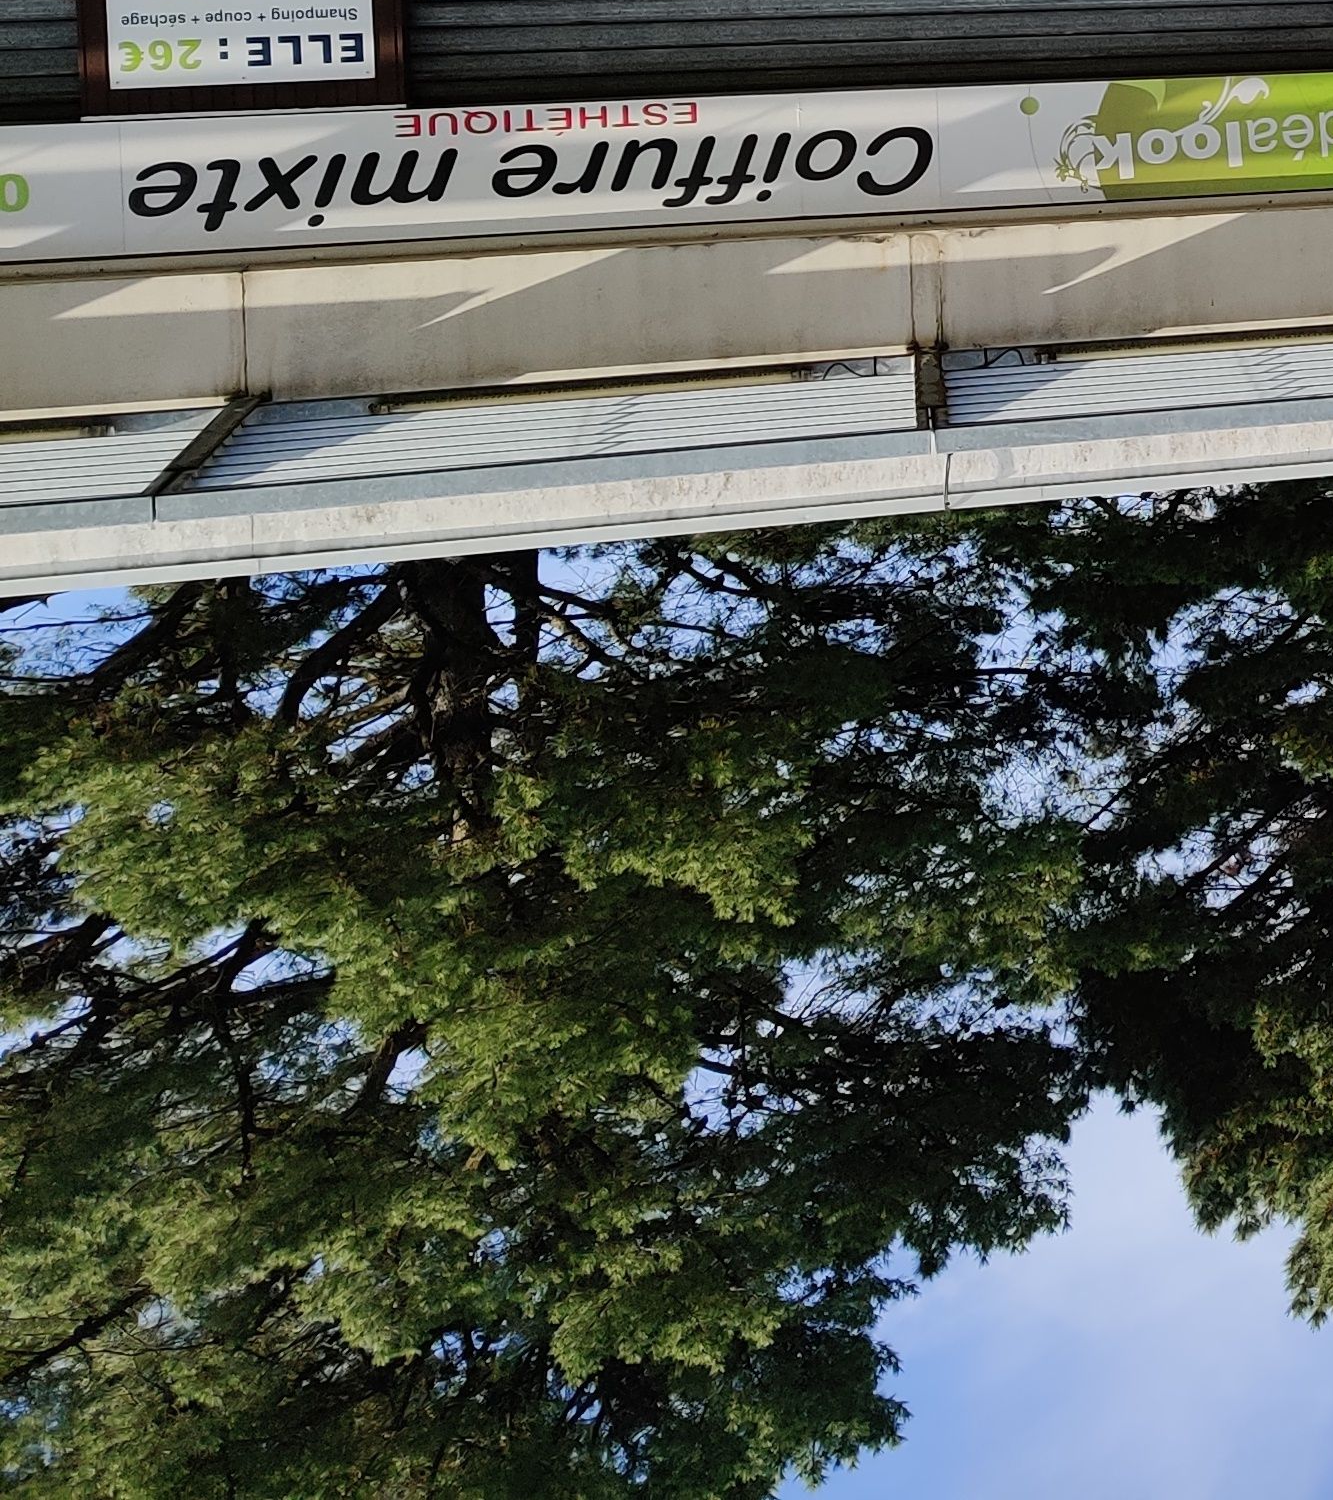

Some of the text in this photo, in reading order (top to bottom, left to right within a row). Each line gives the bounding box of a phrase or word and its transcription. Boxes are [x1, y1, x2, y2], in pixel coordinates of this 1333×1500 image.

[121, 12, 186, 28] séchage
[205, 9, 252, 24] coupe
[271, 6, 358, 23] Shampoing
[118, 38, 202, 72] 26€
[245, 32, 364, 67] ELLE
[393, 101, 698, 138] ESTHÉTIQUE
[128, 126, 934, 233] Coiffure mixte
